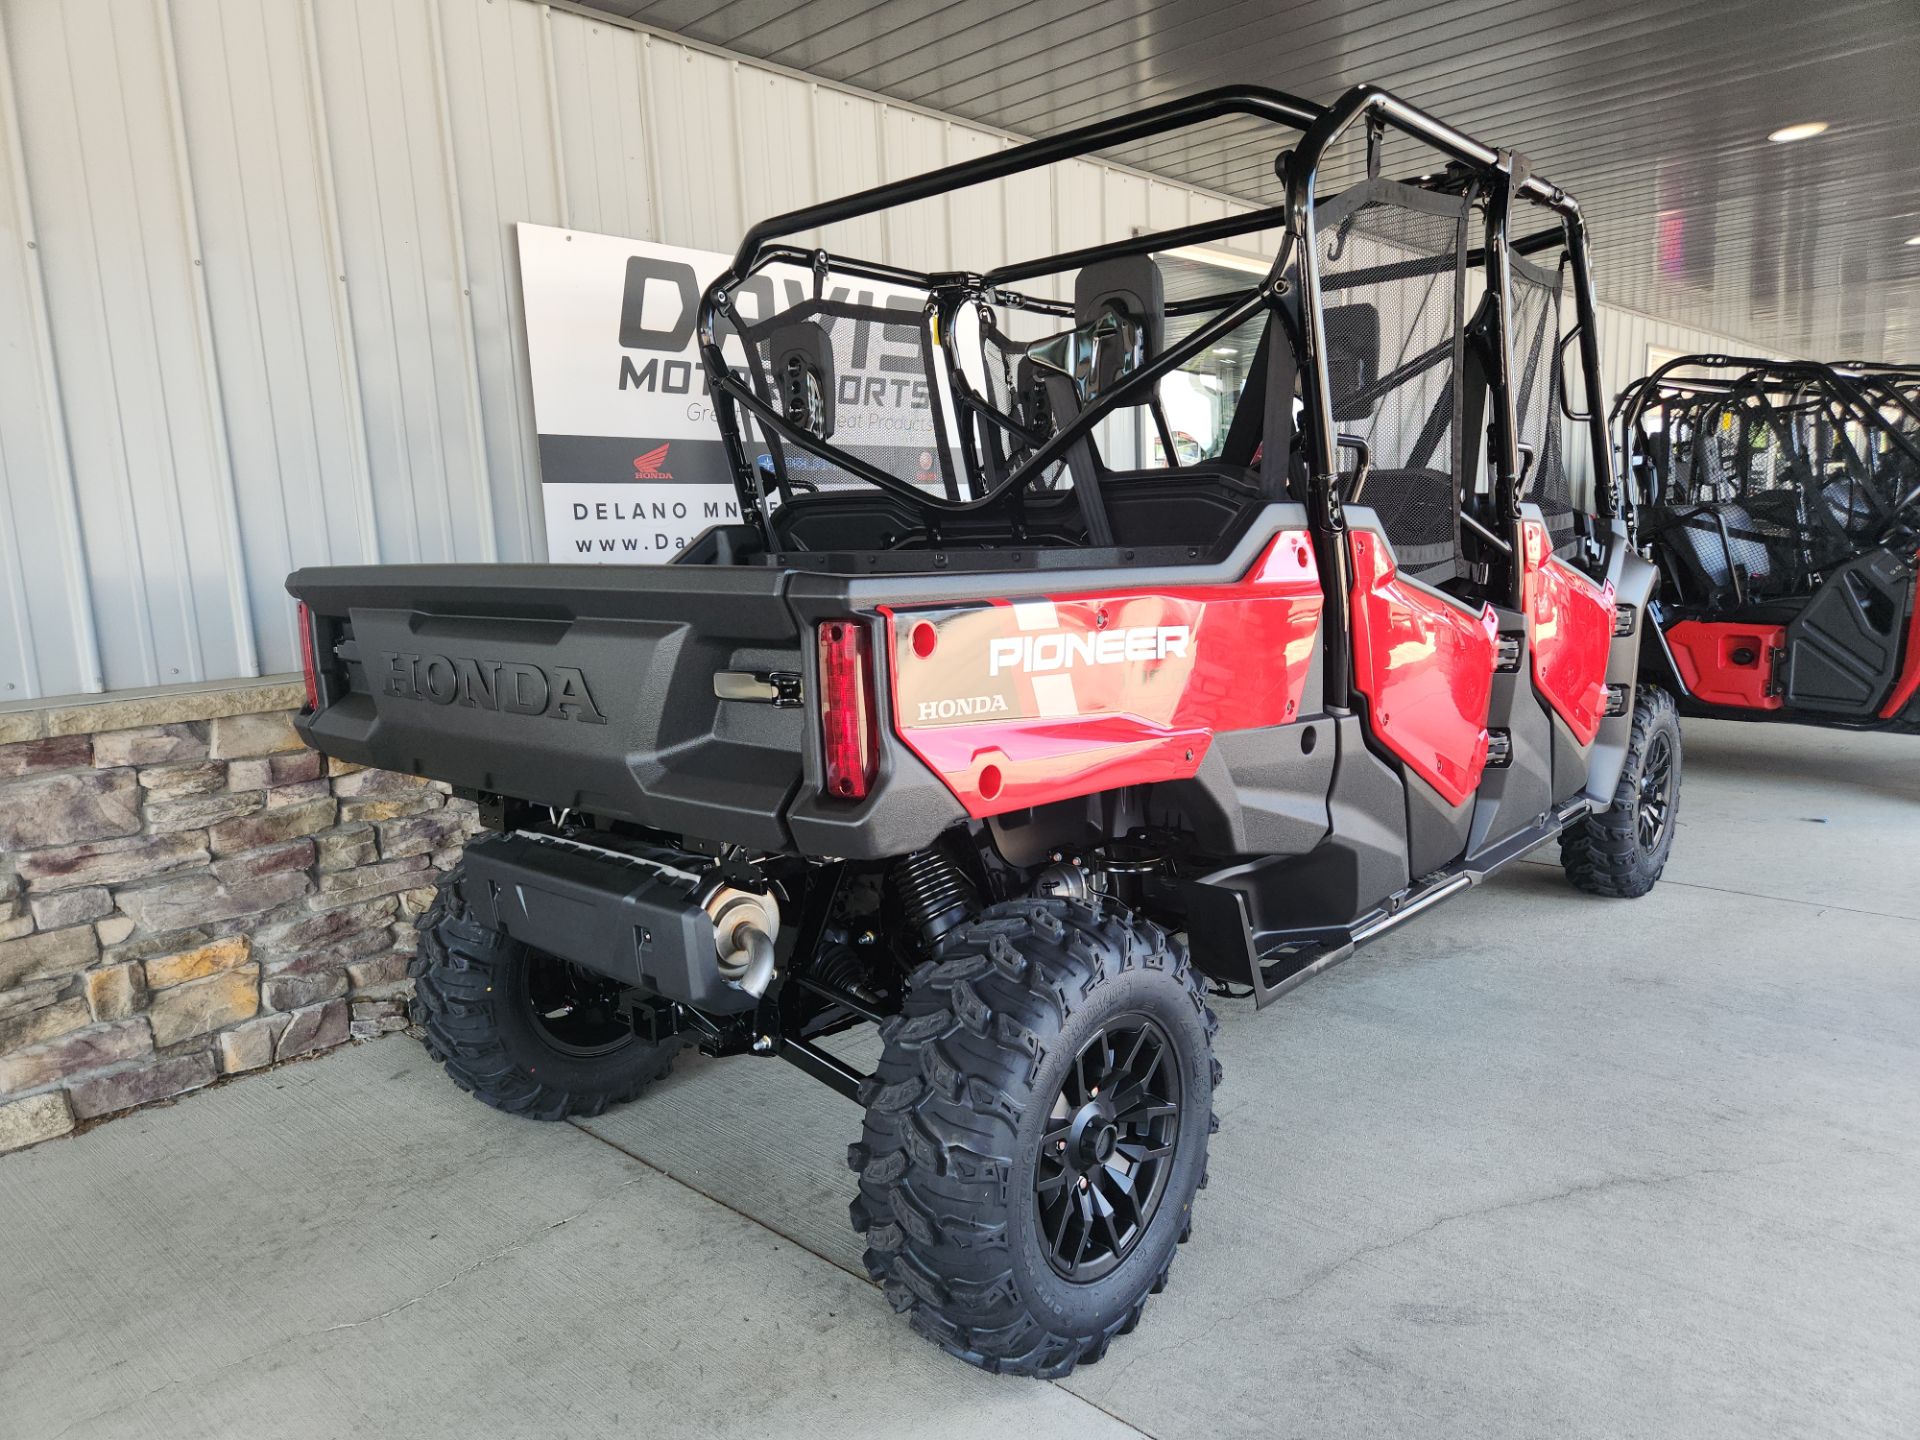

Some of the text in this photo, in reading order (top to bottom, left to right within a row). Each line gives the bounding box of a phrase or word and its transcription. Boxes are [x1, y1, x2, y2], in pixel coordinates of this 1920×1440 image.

[618, 355, 930, 409] MOTORTS
[634, 471, 673, 480] HONDA
[573, 502, 688, 521] DELANO
[703, 502, 738, 519] MN
[575, 533, 694, 553] www.Da
[988, 625, 1190, 677] PIONEER
[380, 650, 608, 726] HONDA
[916, 694, 1009, 721] HONDA
